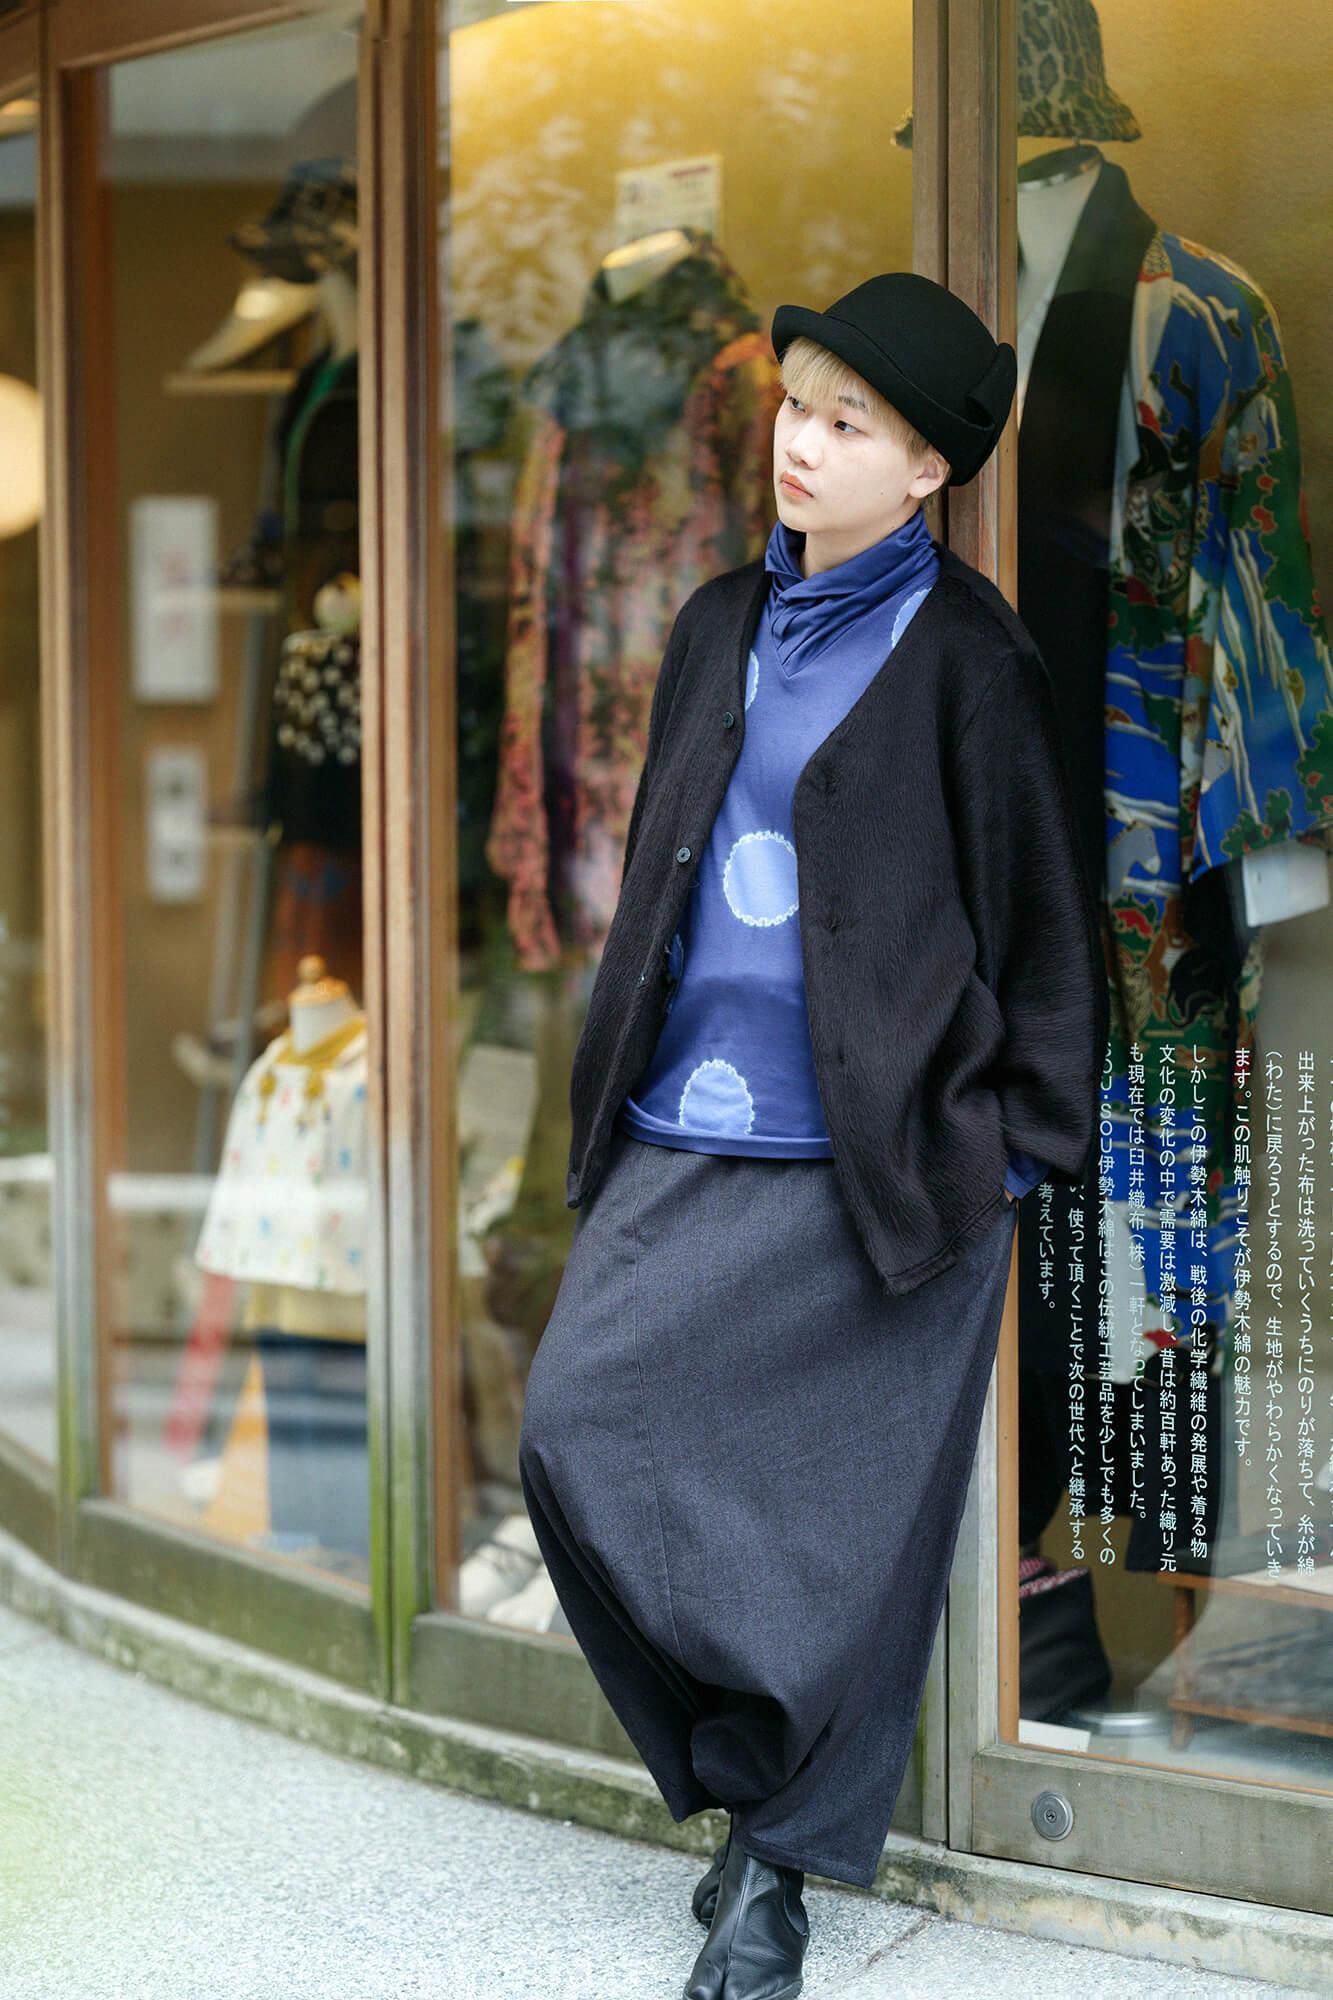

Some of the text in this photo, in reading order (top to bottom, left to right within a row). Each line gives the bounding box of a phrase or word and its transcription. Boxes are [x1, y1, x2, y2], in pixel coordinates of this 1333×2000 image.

[1038, 1182, 1056, 1309] 考えています。
[1159, 1044, 1177, 1572] 文化の変化の中で需要は激減し、昔は約百軒あった織り元
[1190, 1044, 1208, 1559] しかしこの伊勢木綿は、戦後の化学繊維の発展や着る物
[1233, 1048, 1252, 1466] ます。この肌触りこそが伊勢木綿の魅力です。
[1298, 1051, 1316, 1577] 出来上がった布は洗っていくうちにのりが落ちて、糸が綿
